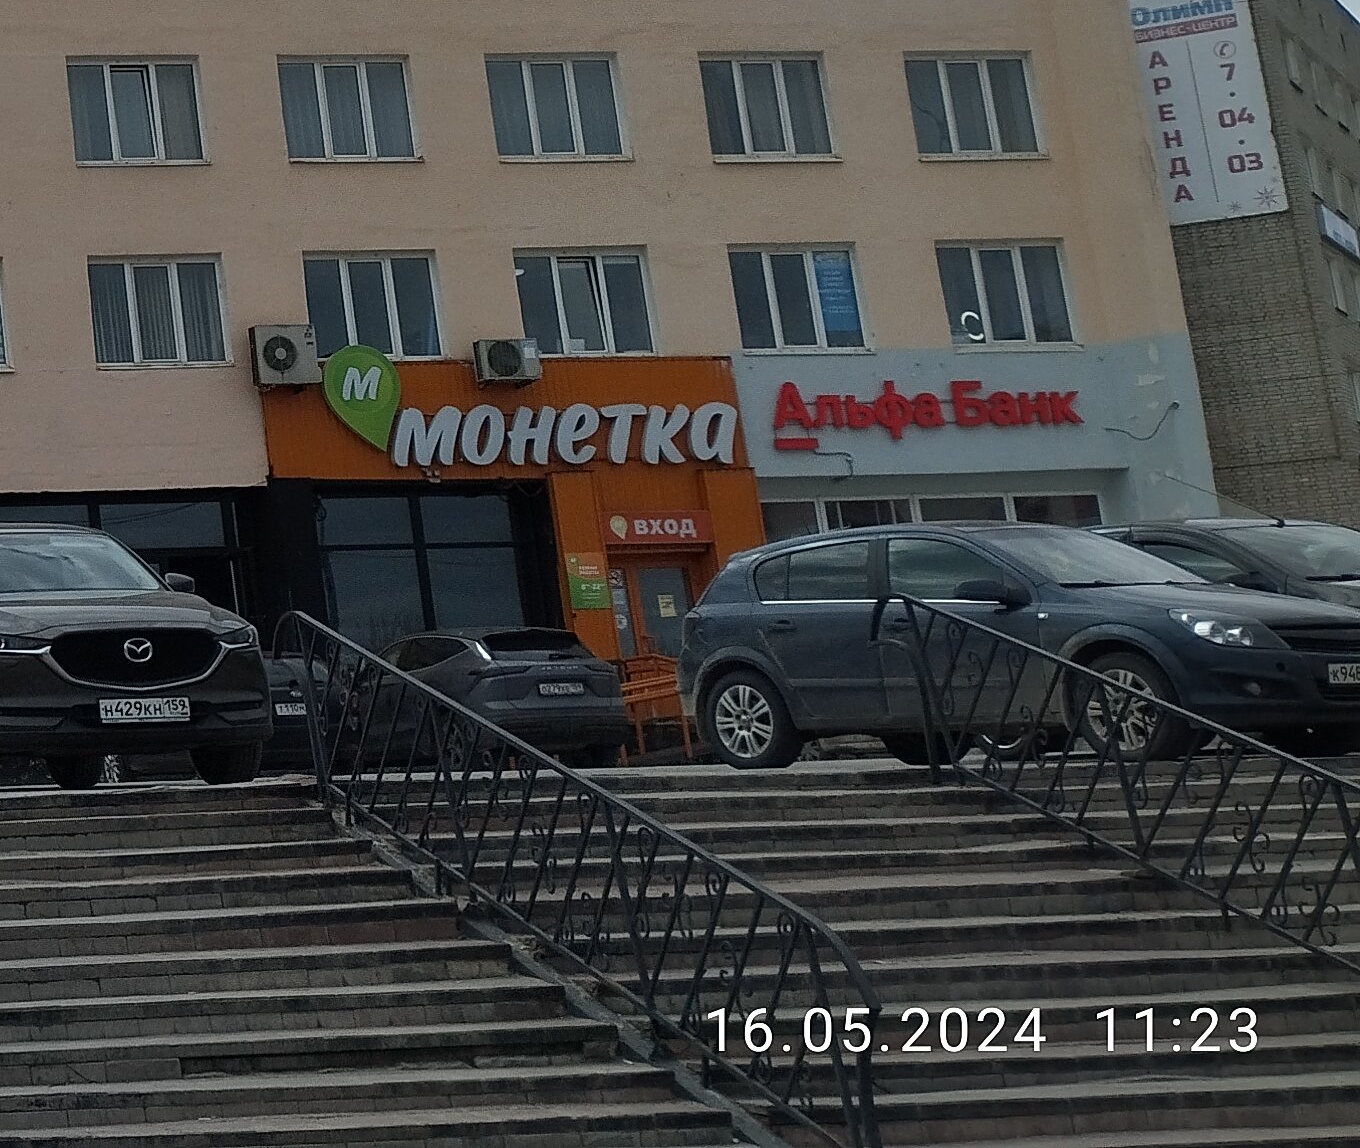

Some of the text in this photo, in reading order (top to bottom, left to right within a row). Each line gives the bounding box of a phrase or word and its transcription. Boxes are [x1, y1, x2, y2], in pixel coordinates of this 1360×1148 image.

[1135, 16, 1237, 42] БИЗНЕС-ЦЕНТР
[1149, 50, 1194, 203] АРЕНДА
[773, 380, 1084, 441] Альфа Банк
[634, 518, 698, 539] ВХОД
[103, 699, 188, 717] Н429КН 159
